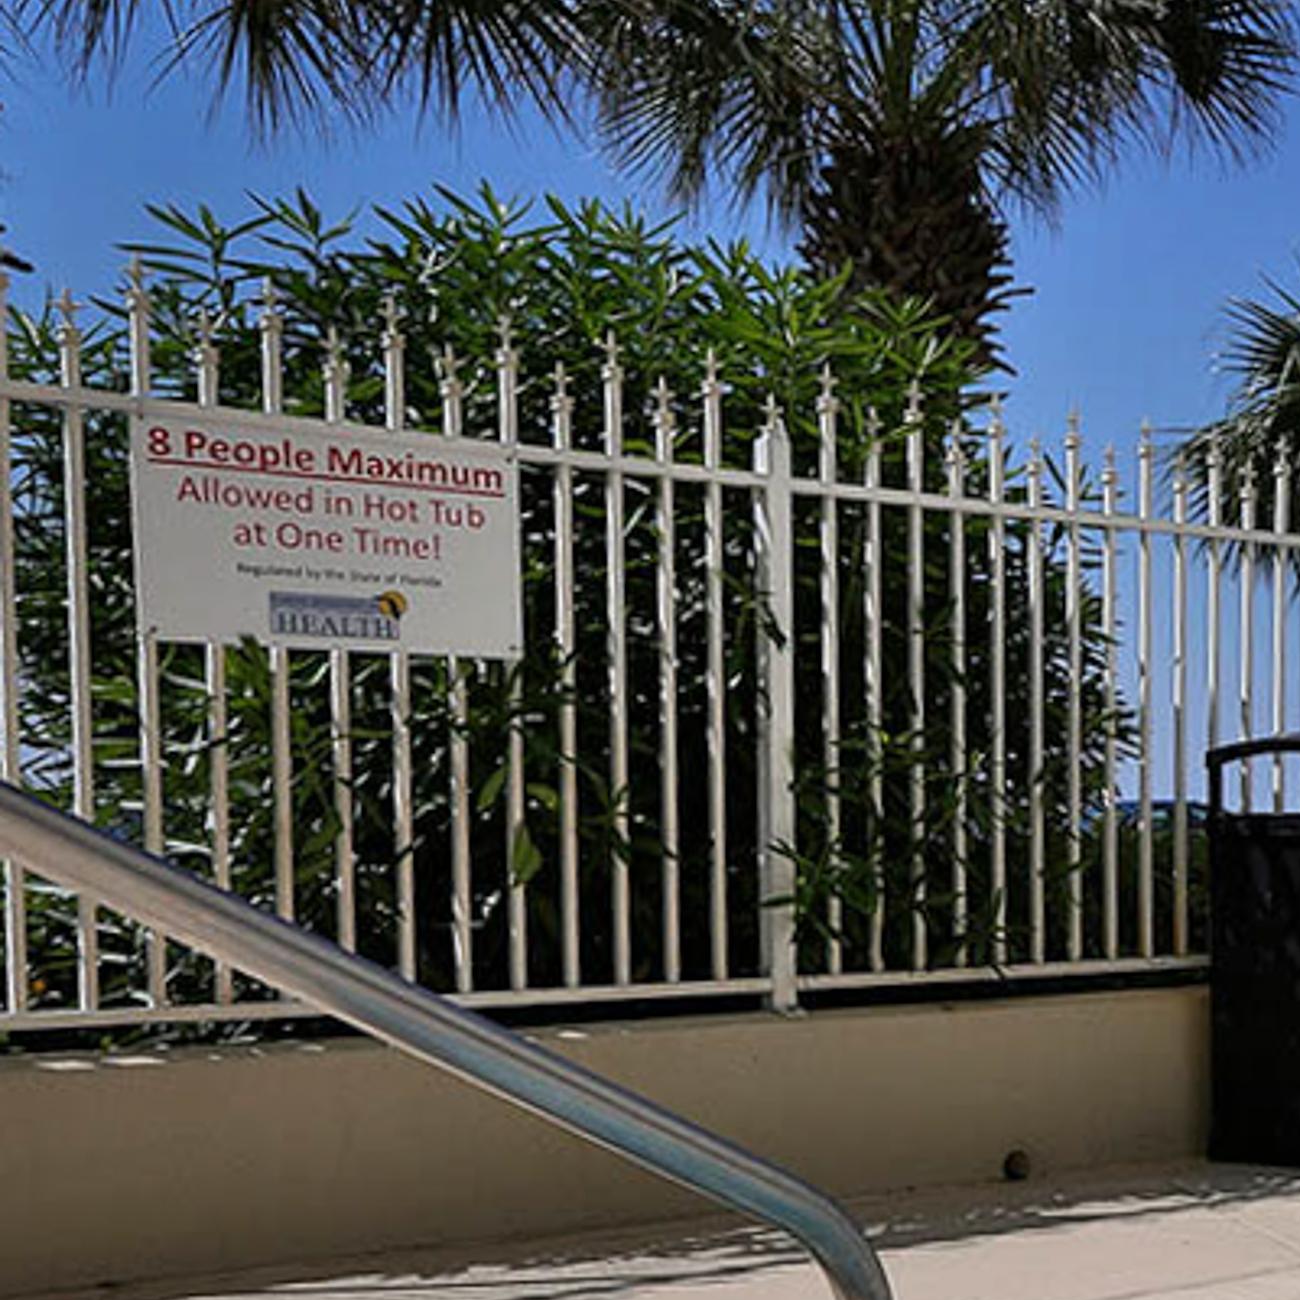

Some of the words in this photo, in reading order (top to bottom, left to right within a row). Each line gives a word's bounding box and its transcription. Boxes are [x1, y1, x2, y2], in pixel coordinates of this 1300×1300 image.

[147, 425, 171, 456] 8
[184, 431, 315, 472] People
[328, 445, 503, 488] Maximum
[177, 475, 314, 514] Allowed
[324, 488, 353, 516] in
[363, 493, 419, 523] Hot
[429, 499, 485, 529] Tub
[233, 522, 268, 547] at
[275, 521, 343, 552] One
[353, 526, 441, 560] Time!
[275, 610, 393, 639] HEALTH
